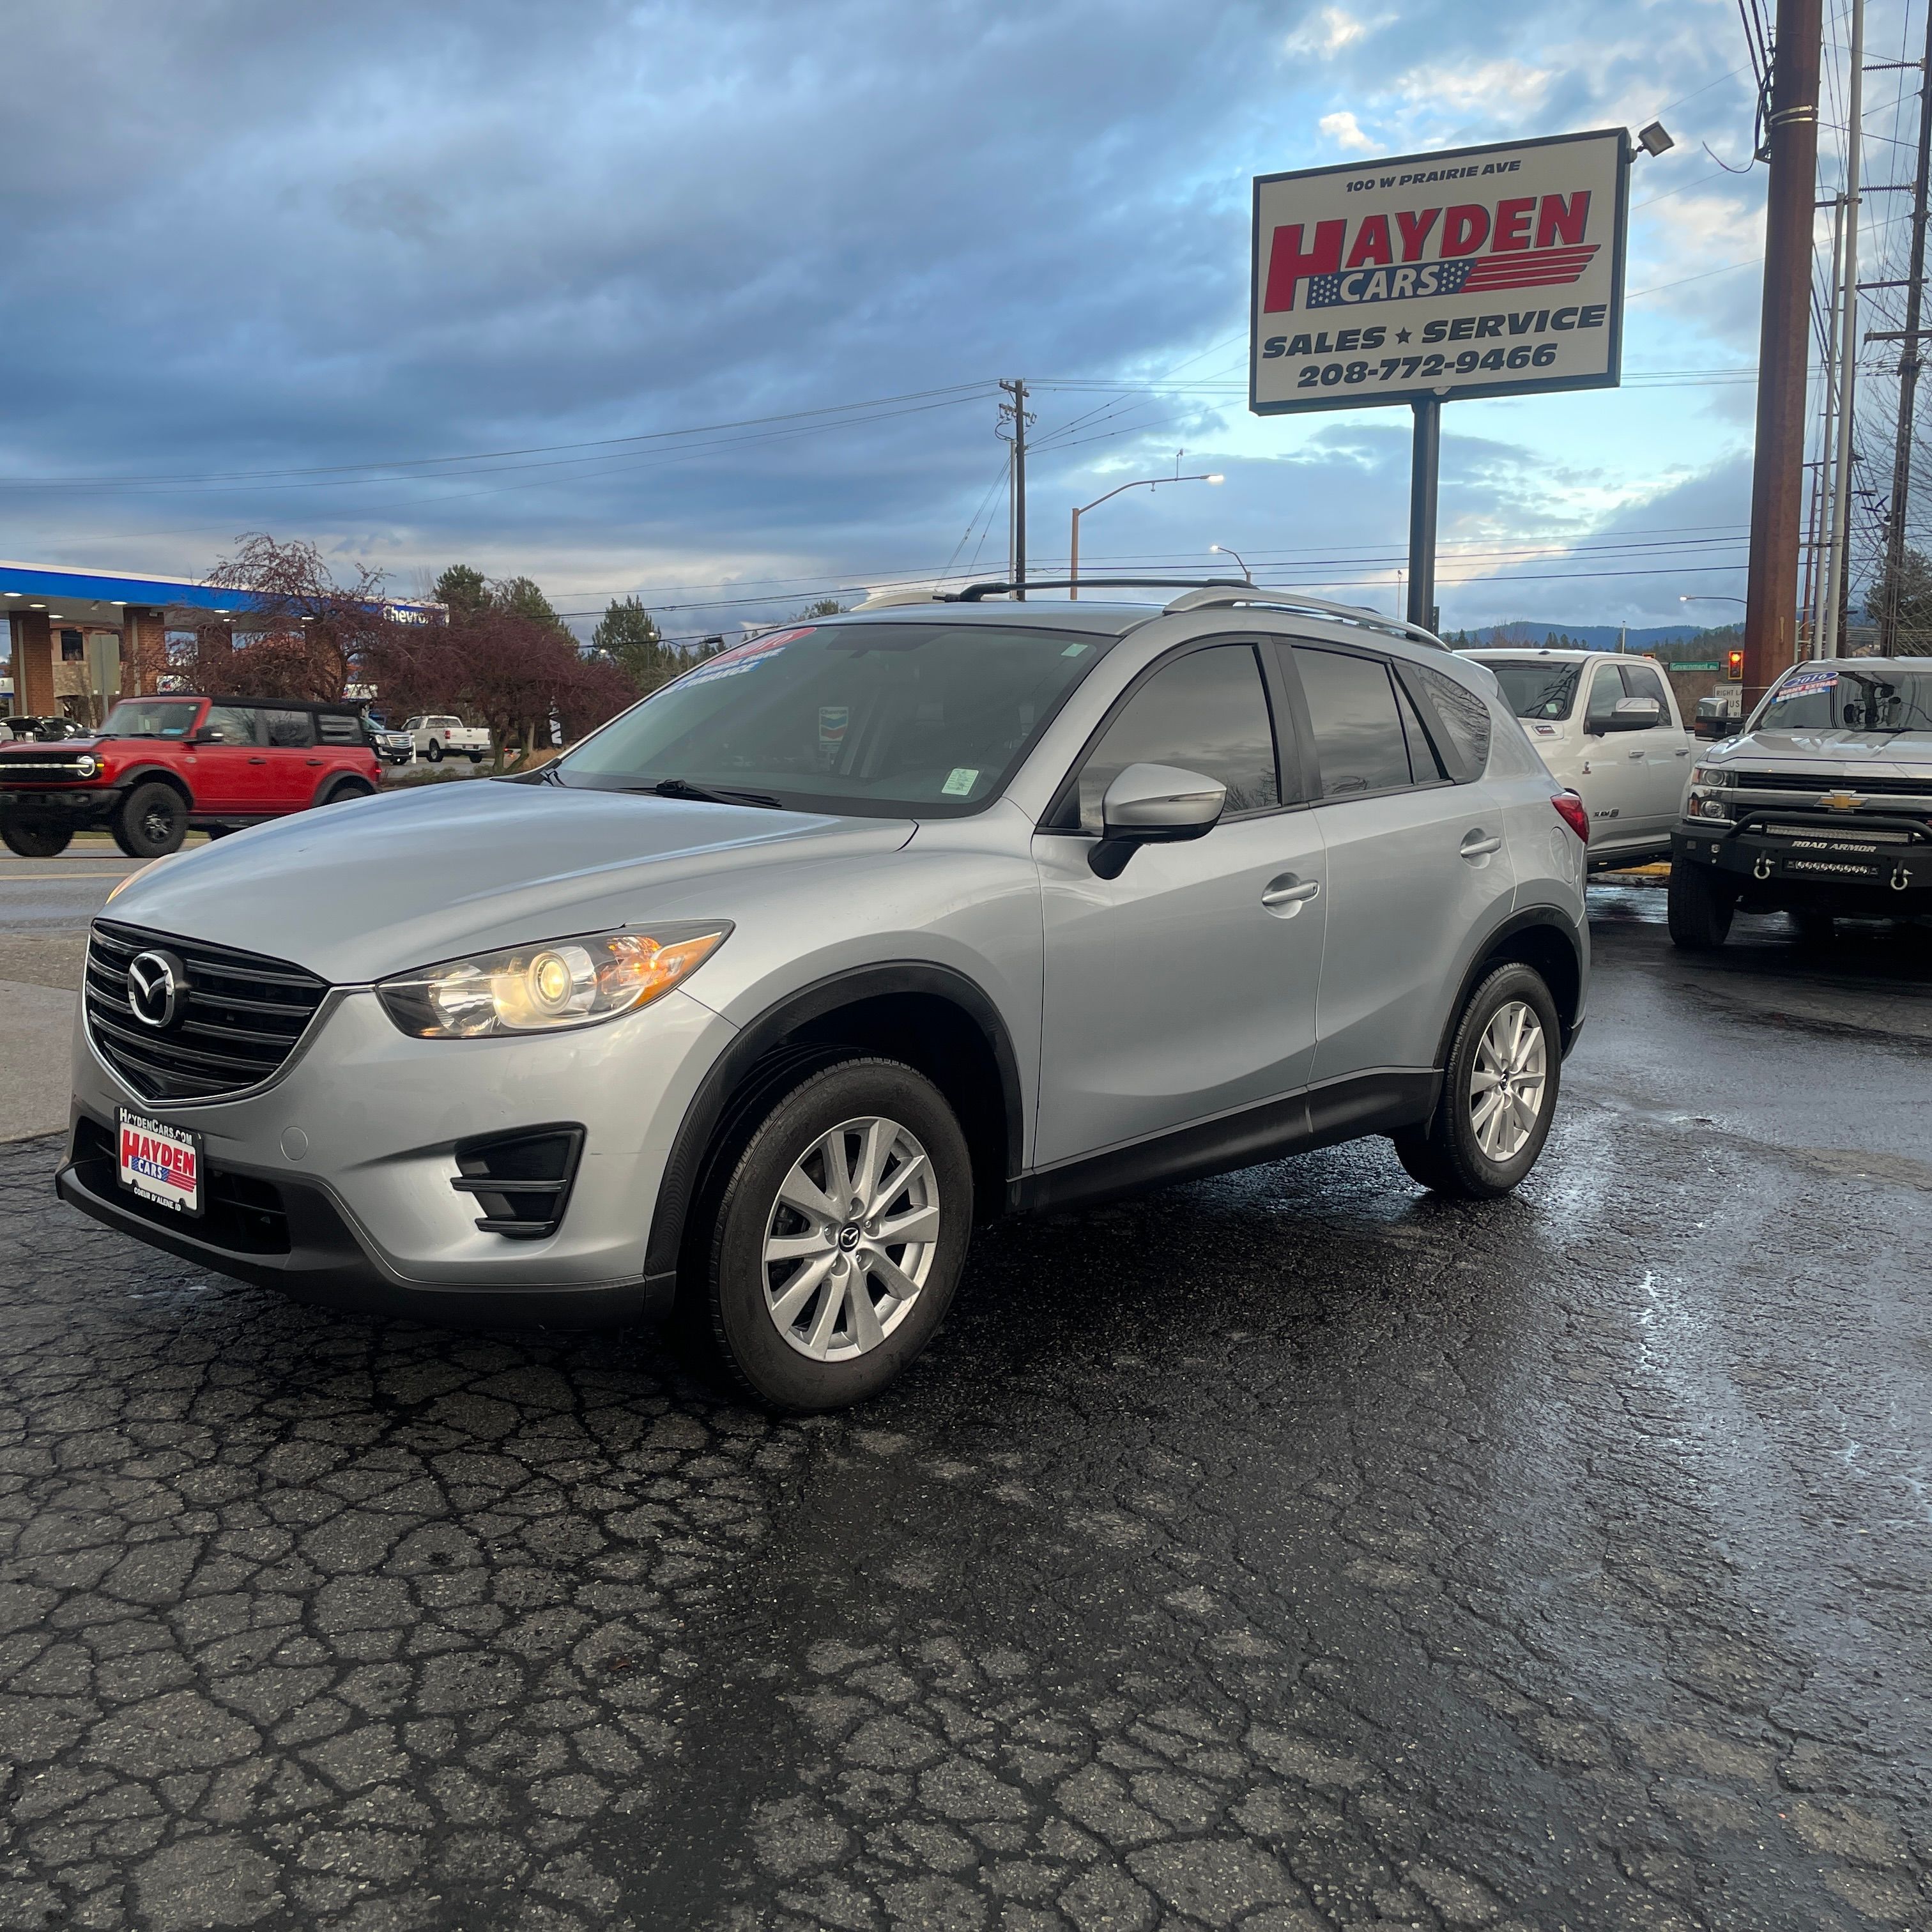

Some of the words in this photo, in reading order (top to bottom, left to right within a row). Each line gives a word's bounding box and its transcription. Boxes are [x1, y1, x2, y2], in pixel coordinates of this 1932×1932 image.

[1346, 180, 1376, 192] 100
[1379, 176, 1397, 188] W
[1399, 165, 1479, 186] PRAIRIE
[1481, 160, 1521, 175] AVE
[1264, 190, 1591, 313] HAYDEN
[1339, 264, 1441, 303] CARS
[1262, 326, 1386, 359] SALES
[1422, 304, 1607, 343] SERVICE
[1297, 343, 1558, 388] 208-772-9466
[678, 661, 760, 691] FINANCE
[1779, 686, 1804, 696] MANY
[1805, 680, 1838, 690] EXTRAS
[1793, 674, 1827, 685] 2016
[1729, 700, 1740, 708] US
[1776, 687, 1826, 702] DIESEL
[1791, 841, 1828, 849] ROAD
[1829, 843, 1876, 853] ARMOR
[122, 1129, 195, 1177] HAYDEN
[138, 1159, 162, 1179] CARS
[134, 1186, 151, 1200] COEUR
[174, 1203, 181, 1211] ID
